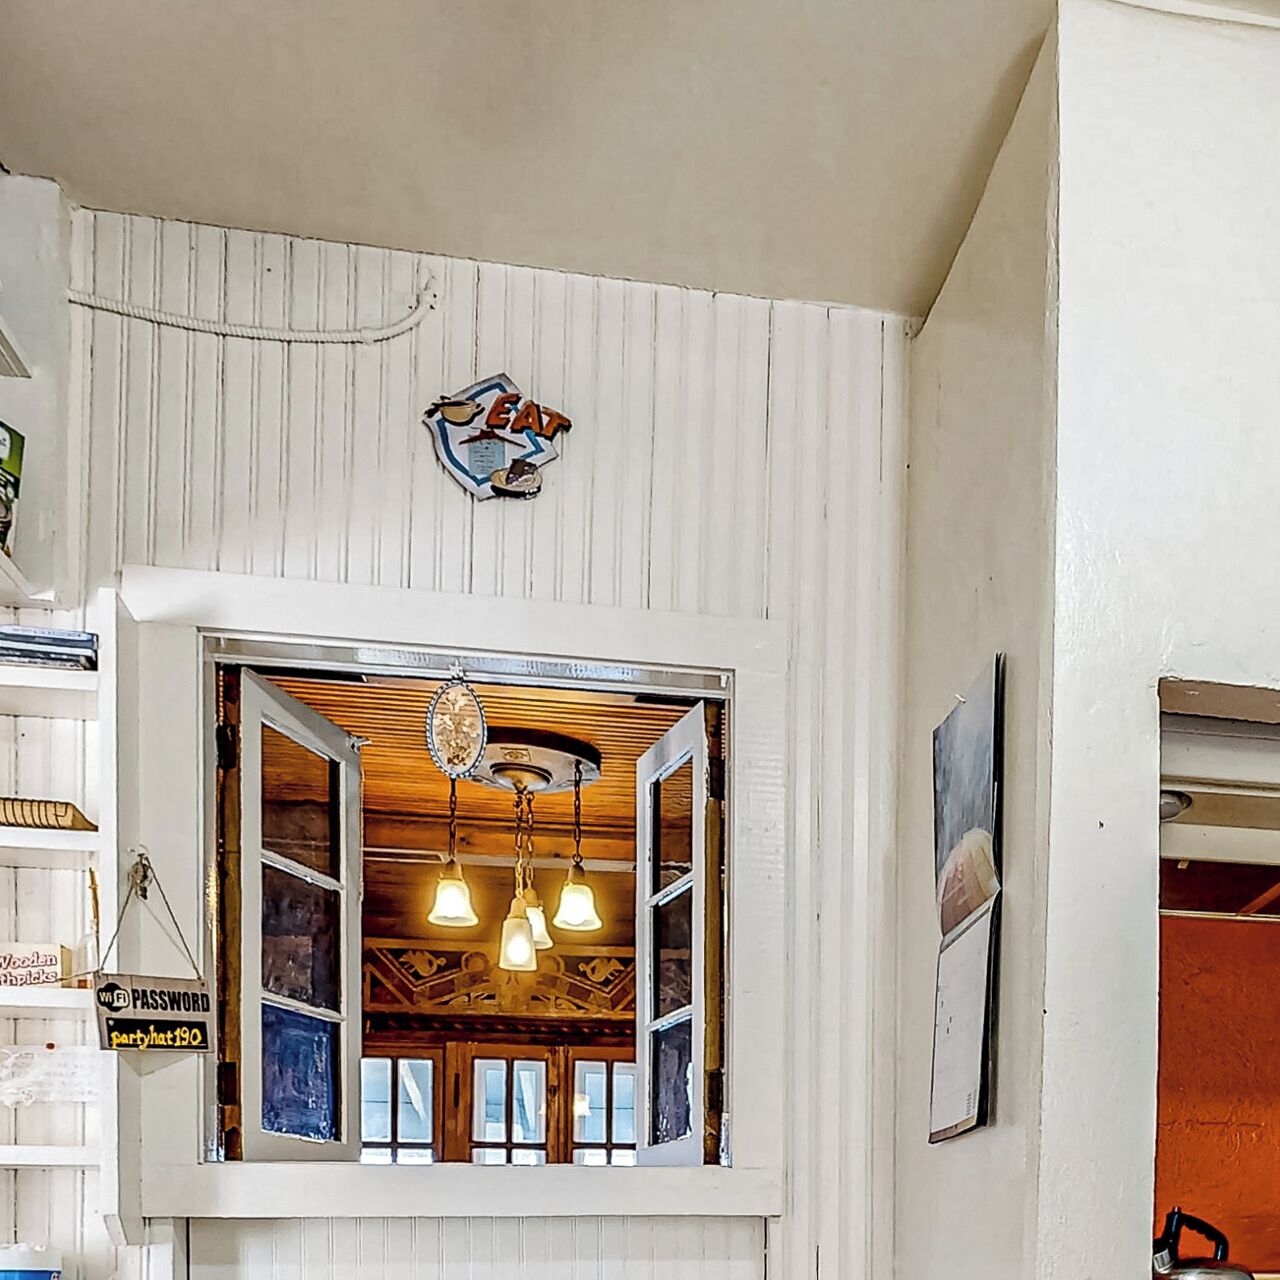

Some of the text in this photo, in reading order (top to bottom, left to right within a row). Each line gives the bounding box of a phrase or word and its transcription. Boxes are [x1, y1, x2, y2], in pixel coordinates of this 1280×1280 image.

[485, 393, 572, 442] EAT
[132, 989, 210, 1012] PASSWORD
[111, 1025, 202, 1050] partyhat190
